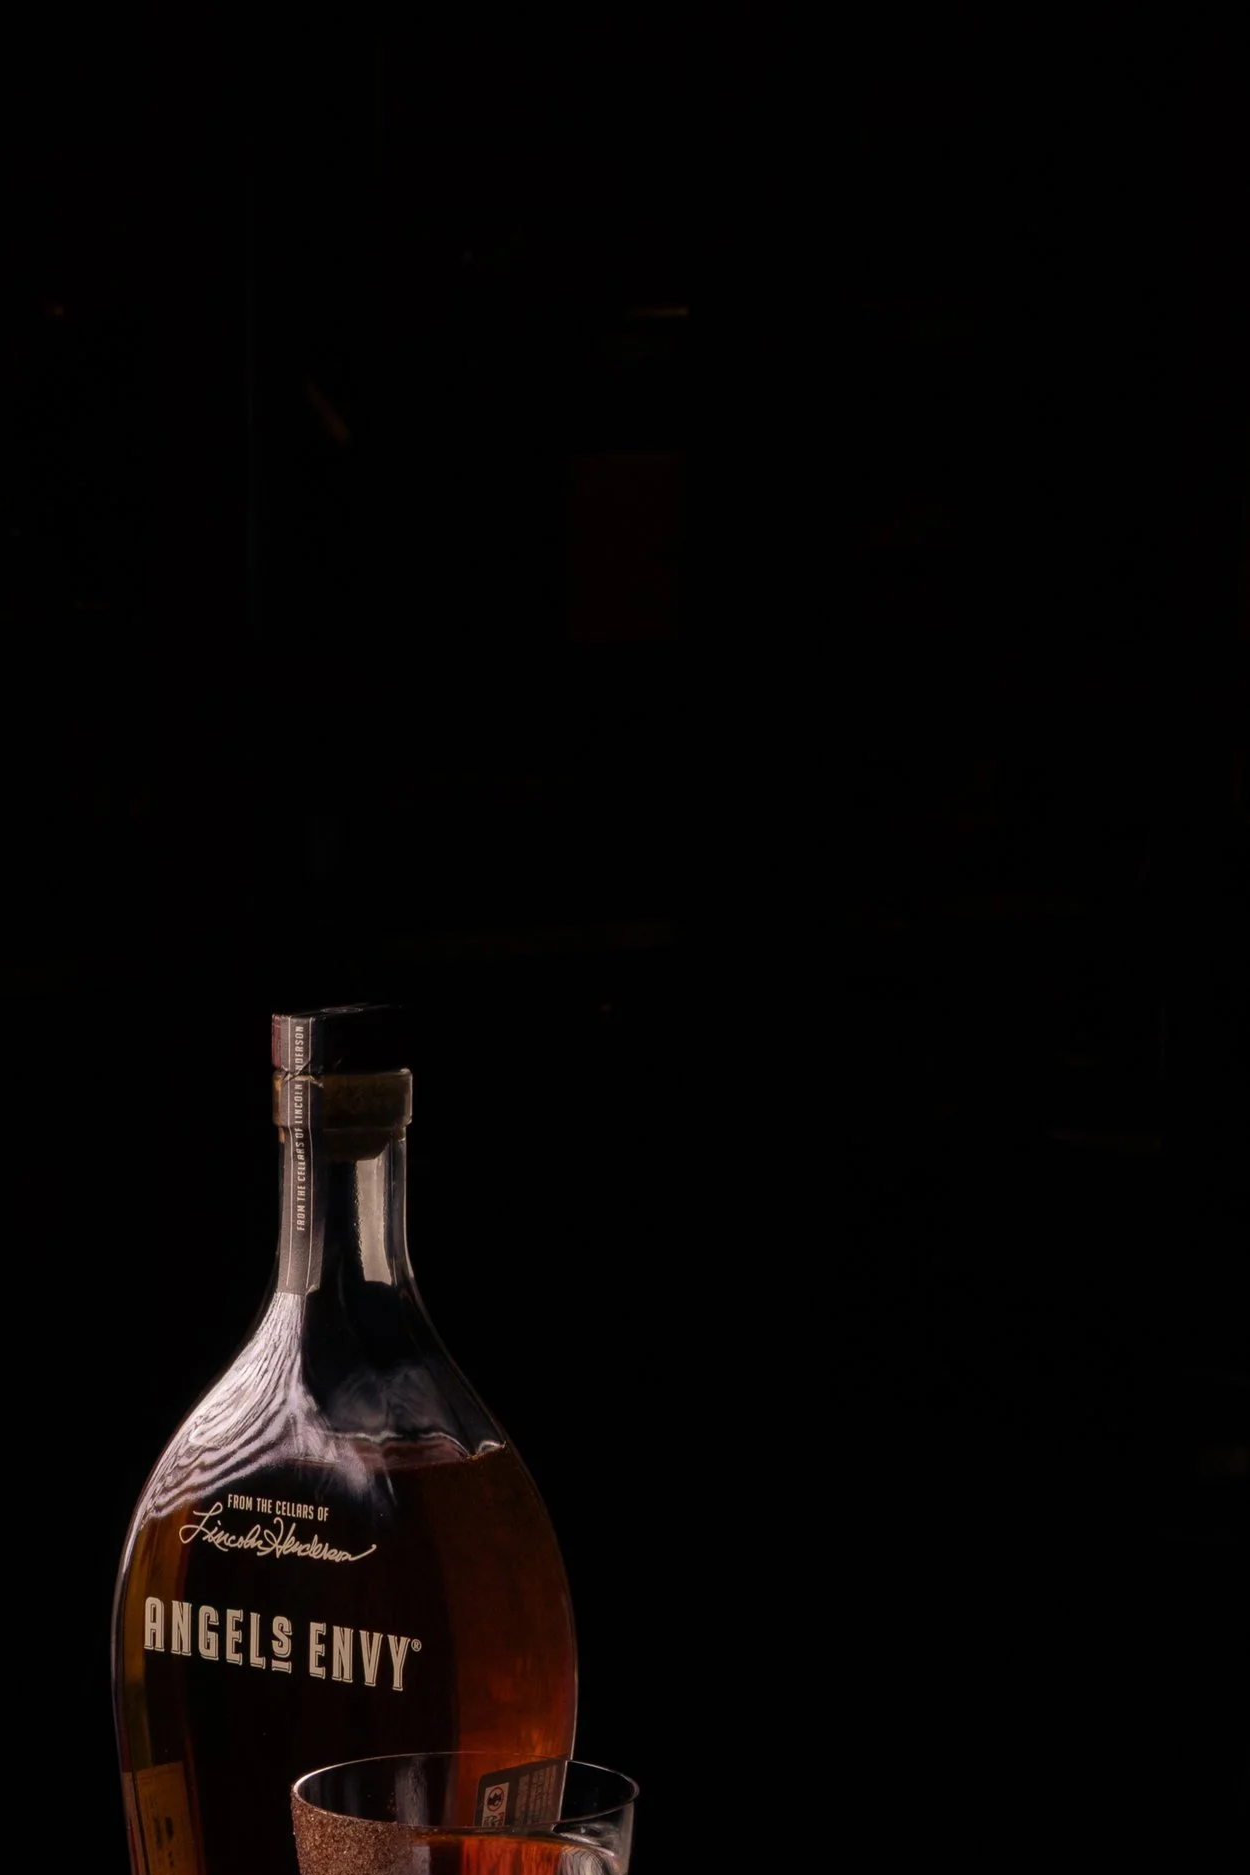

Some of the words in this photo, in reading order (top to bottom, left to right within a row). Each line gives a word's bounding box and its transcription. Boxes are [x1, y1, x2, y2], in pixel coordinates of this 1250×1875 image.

[294, 1084, 303, 1124] LINCOLN
[294, 1128, 304, 1139] OF
[295, 1142, 306, 1182] CELLARS
[296, 1185, 306, 1201] THE
[296, 1205, 306, 1231] FROM
[227, 1494, 252, 1510] FROM
[256, 1497, 272, 1514] THE
[275, 1500, 314, 1520] CELLARS
[317, 1506, 330, 1522] OF
[178, 1502, 264, 1551] Lincoln
[144, 1596, 293, 1674] ANGELS
